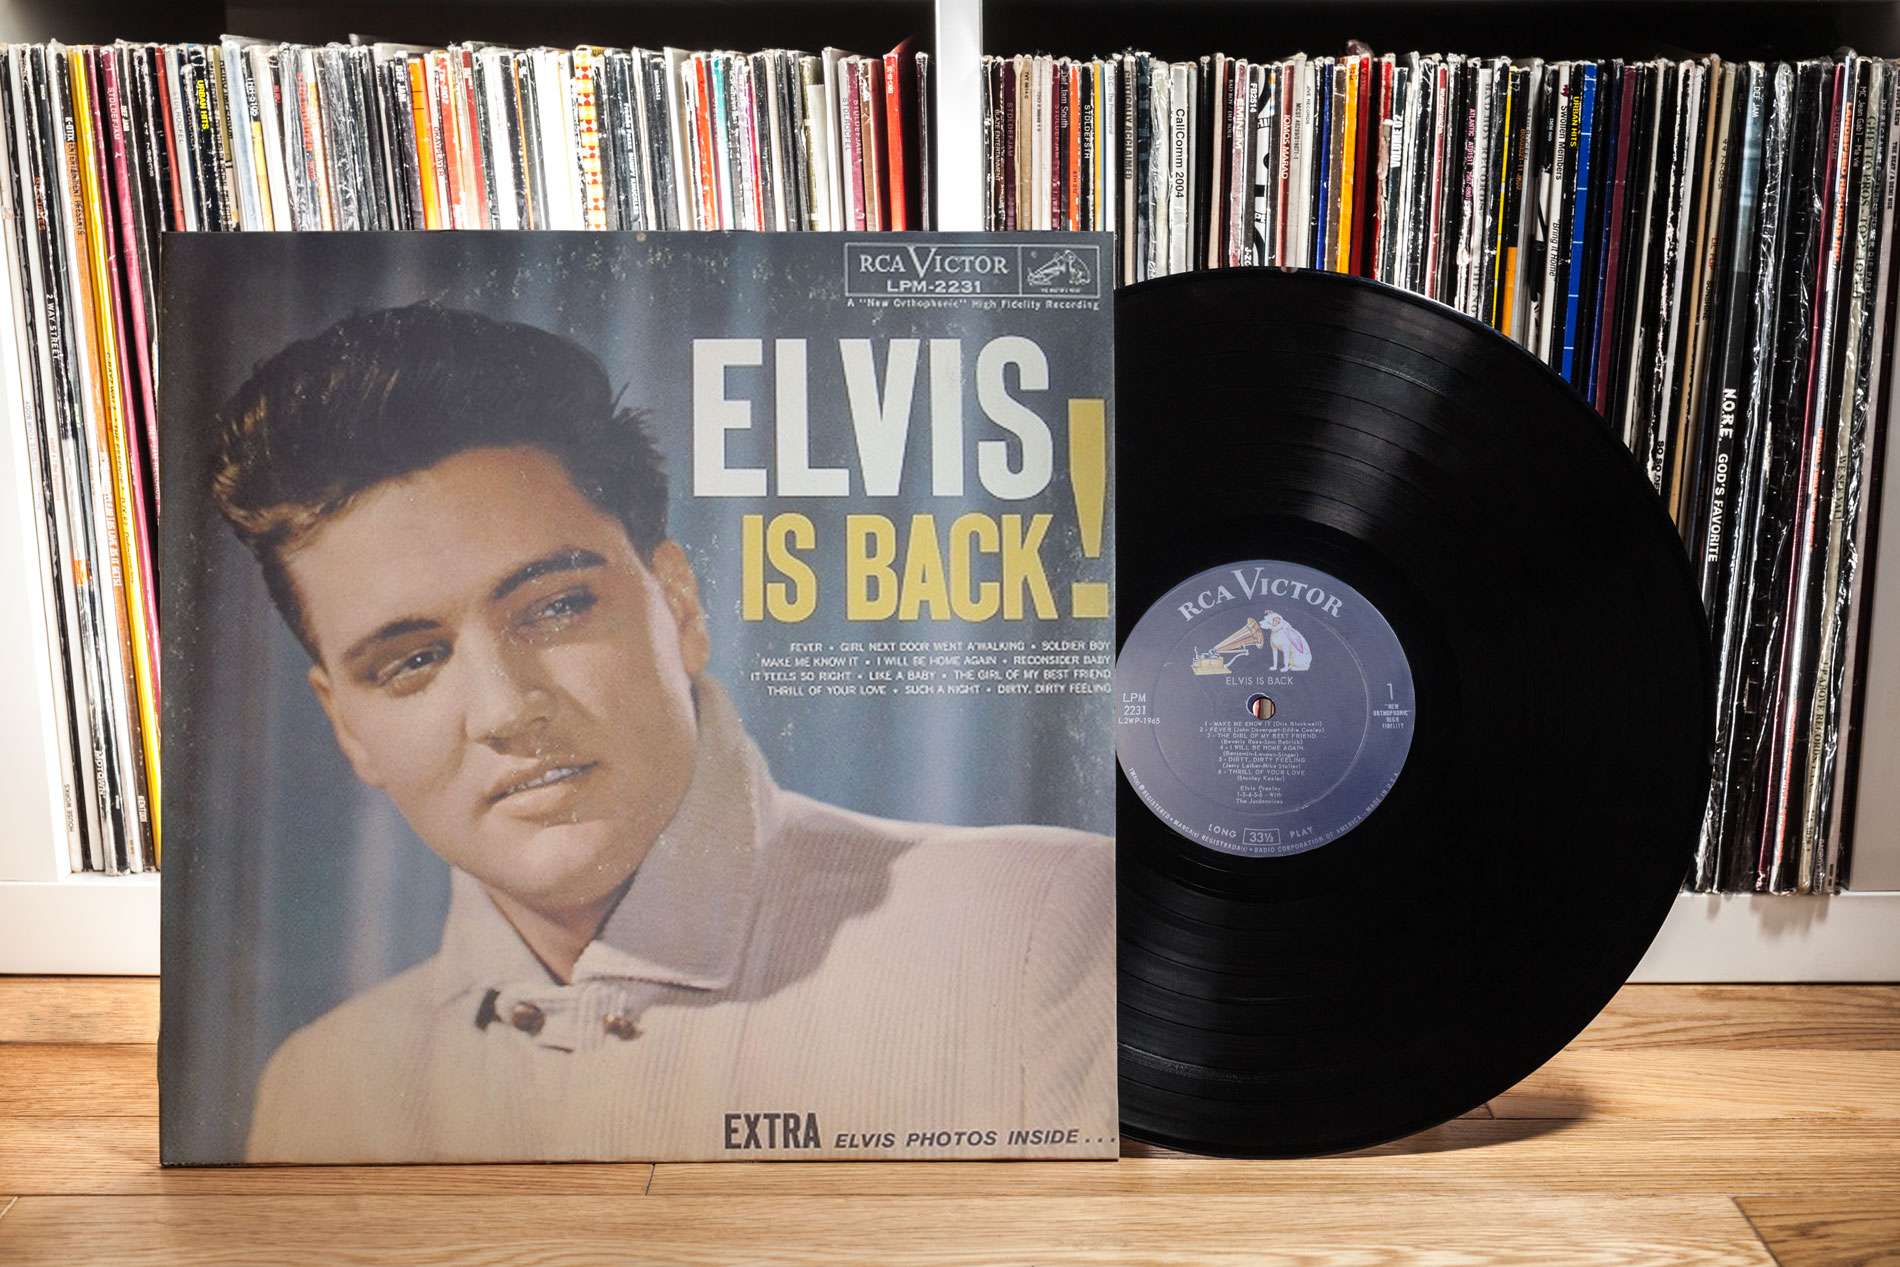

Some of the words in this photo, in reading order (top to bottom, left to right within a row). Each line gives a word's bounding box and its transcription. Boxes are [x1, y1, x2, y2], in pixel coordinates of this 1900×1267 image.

[395, 65, 405, 82] DEF
[196, 79, 208, 108] URBAN
[397, 83, 407, 102] JAM
[1060, 87, 1068, 104] Jam
[1124, 70, 1133, 123] CRITICALLY
[1752, 86, 1760, 100] DEF
[199, 110, 209, 130] HITS
[1060, 106, 1068, 129] South
[1392, 114, 1403, 128] 02
[1468, 108, 1476, 137] ATLANTIC
[1559, 105, 1568, 139] Swollen
[1571, 96, 1580, 126] URBAN
[1751, 102, 1759, 118] JAM
[1175, 108, 1186, 168] CaliComm
[1390, 128, 1402, 168] VOLUME
[1569, 128, 1578, 148] HITS
[1862, 115, 1877, 171] GHETTO
[1124, 125, 1133, 180] ACCLAIMED
[1555, 141, 1566, 181] Members
[1175, 171, 1186, 198] 2004
[1478, 147, 1489, 213] RECORDS
[1860, 174, 1872, 207] PROS
[860, 254, 906, 273] RCA
[907, 246, 1009, 278] VICTOR
[887, 280, 982, 294] LPM-2231
[47, 302, 56, 322] WAY
[50, 324, 60, 360] STREET
[693, 335, 1053, 500] ELVIS
[1718, 387, 1738, 442] N.O.R.E.
[1657, 440, 1665, 455] SO
[1655, 457, 1663, 472] SO
[1715, 453, 1729, 496] GOD'S
[1707, 497, 1724, 563] FAVORITE
[742, 512, 816, 623] IS
[1177, 585, 1236, 622] RCA
[1232, 567, 1346, 618] VICTOR
[760, 657, 791, 667] MAKE
[813, 657, 847, 667] KNOW
[869, 671, 893, 681] LIKE
[907, 671, 936, 681] BABY
[1225, 676, 1254, 686] ELVIS
[1256, 676, 1265, 686] IS
[1267, 676, 1295, 686] BACK
[905, 685, 934, 695] SUCH
[1122, 692, 1146, 703] LPM
[1386, 683, 1394, 700] 1
[1124, 705, 1146, 716] 2231
[1812, 713, 1825, 759] RECORDS
[1208, 823, 1237, 839] LONG
[1289, 825, 1313, 839] PLAY
[724, 1112, 822, 1149] EXTRA
[834, 1132, 896, 1149] ELVIS
[906, 1130, 998, 1147] PHOTOS
